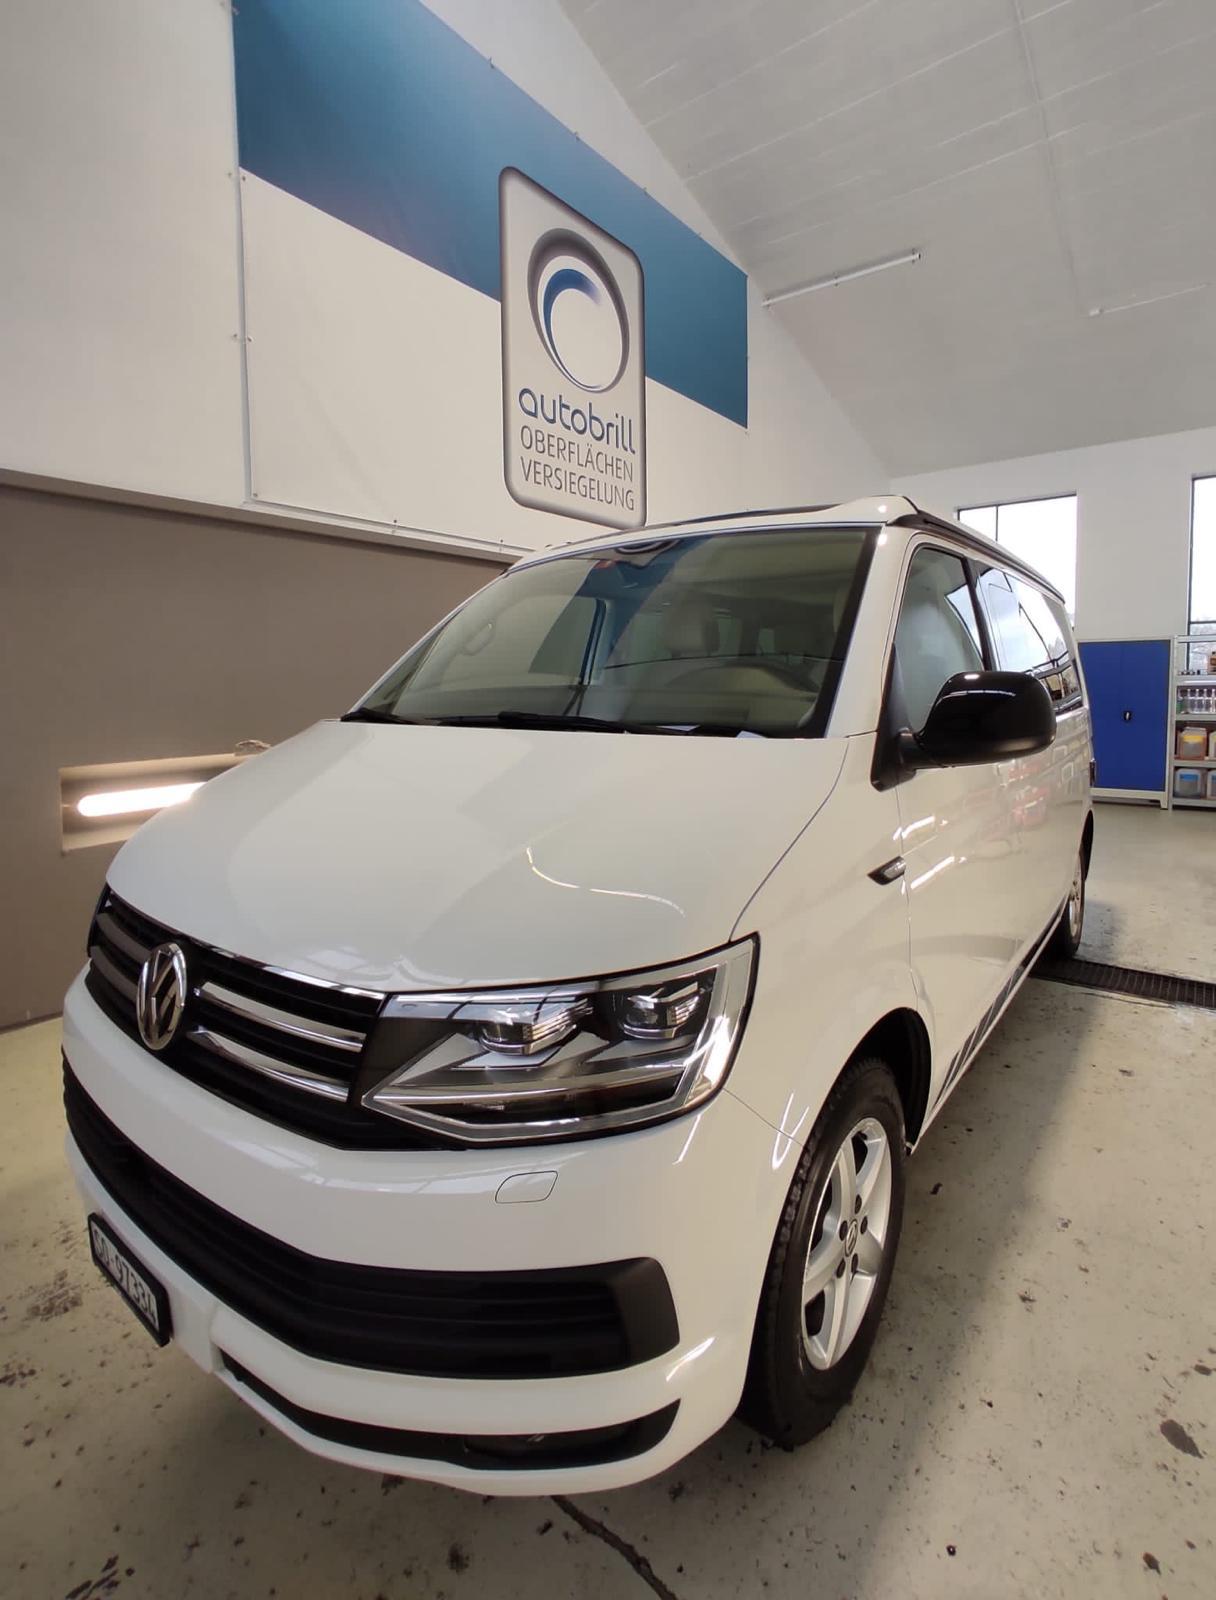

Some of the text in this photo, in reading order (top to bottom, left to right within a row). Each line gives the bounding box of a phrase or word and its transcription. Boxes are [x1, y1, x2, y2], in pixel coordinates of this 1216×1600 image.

[518, 387, 636, 455] autobrill
[520, 425, 633, 483] OBERFLÄCHEN
[520, 456, 635, 511] VERSIEGELUNG
